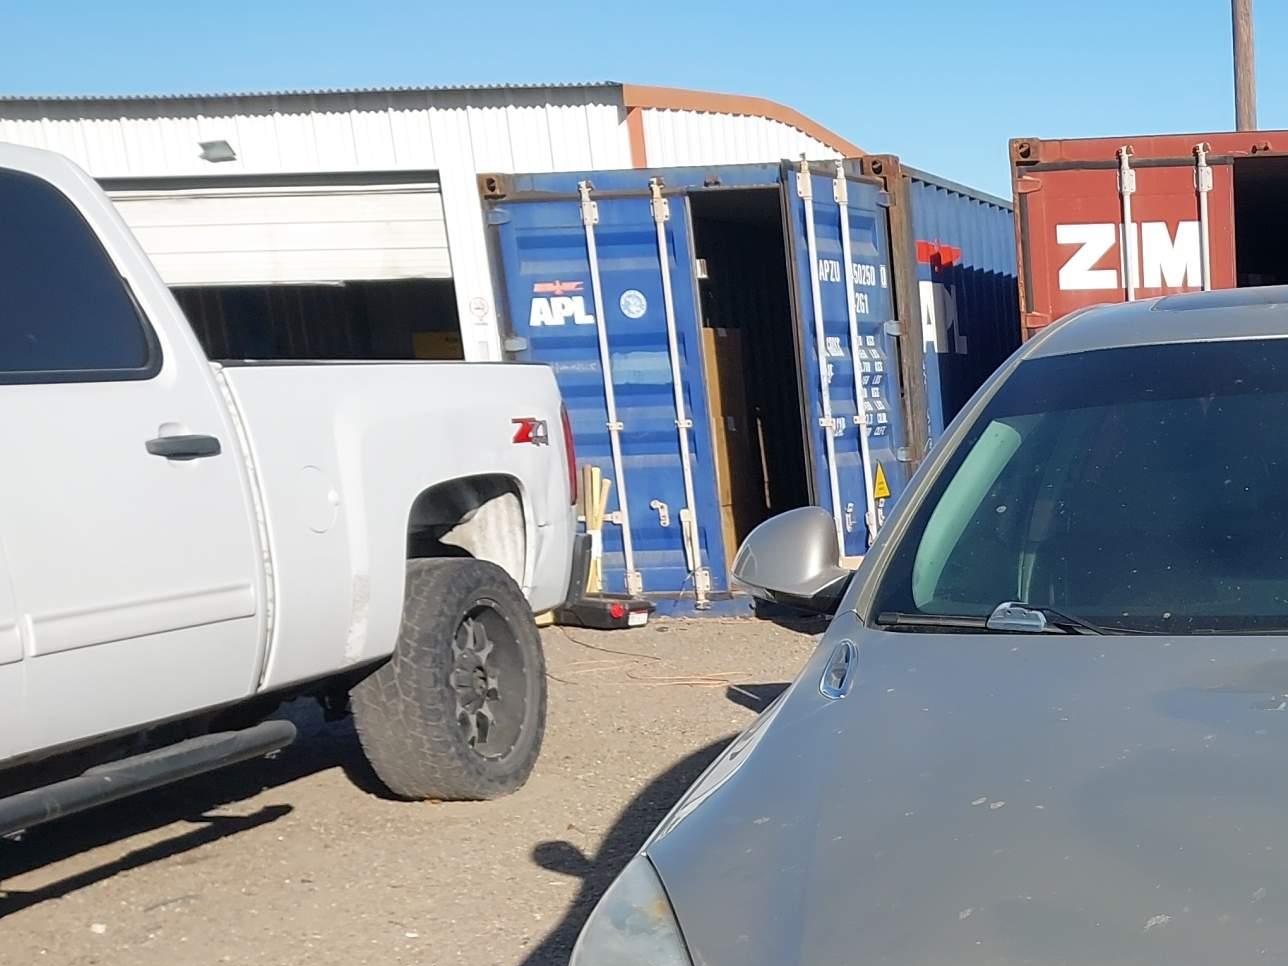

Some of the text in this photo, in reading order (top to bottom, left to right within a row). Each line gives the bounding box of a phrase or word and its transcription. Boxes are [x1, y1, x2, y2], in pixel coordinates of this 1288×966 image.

[819, 259, 840, 282] APZU
[852, 263, 877, 286] 50250
[1056, 221, 1201, 290] ZIM
[529, 296, 595, 326] APL
[919, 281, 968, 354] APL
